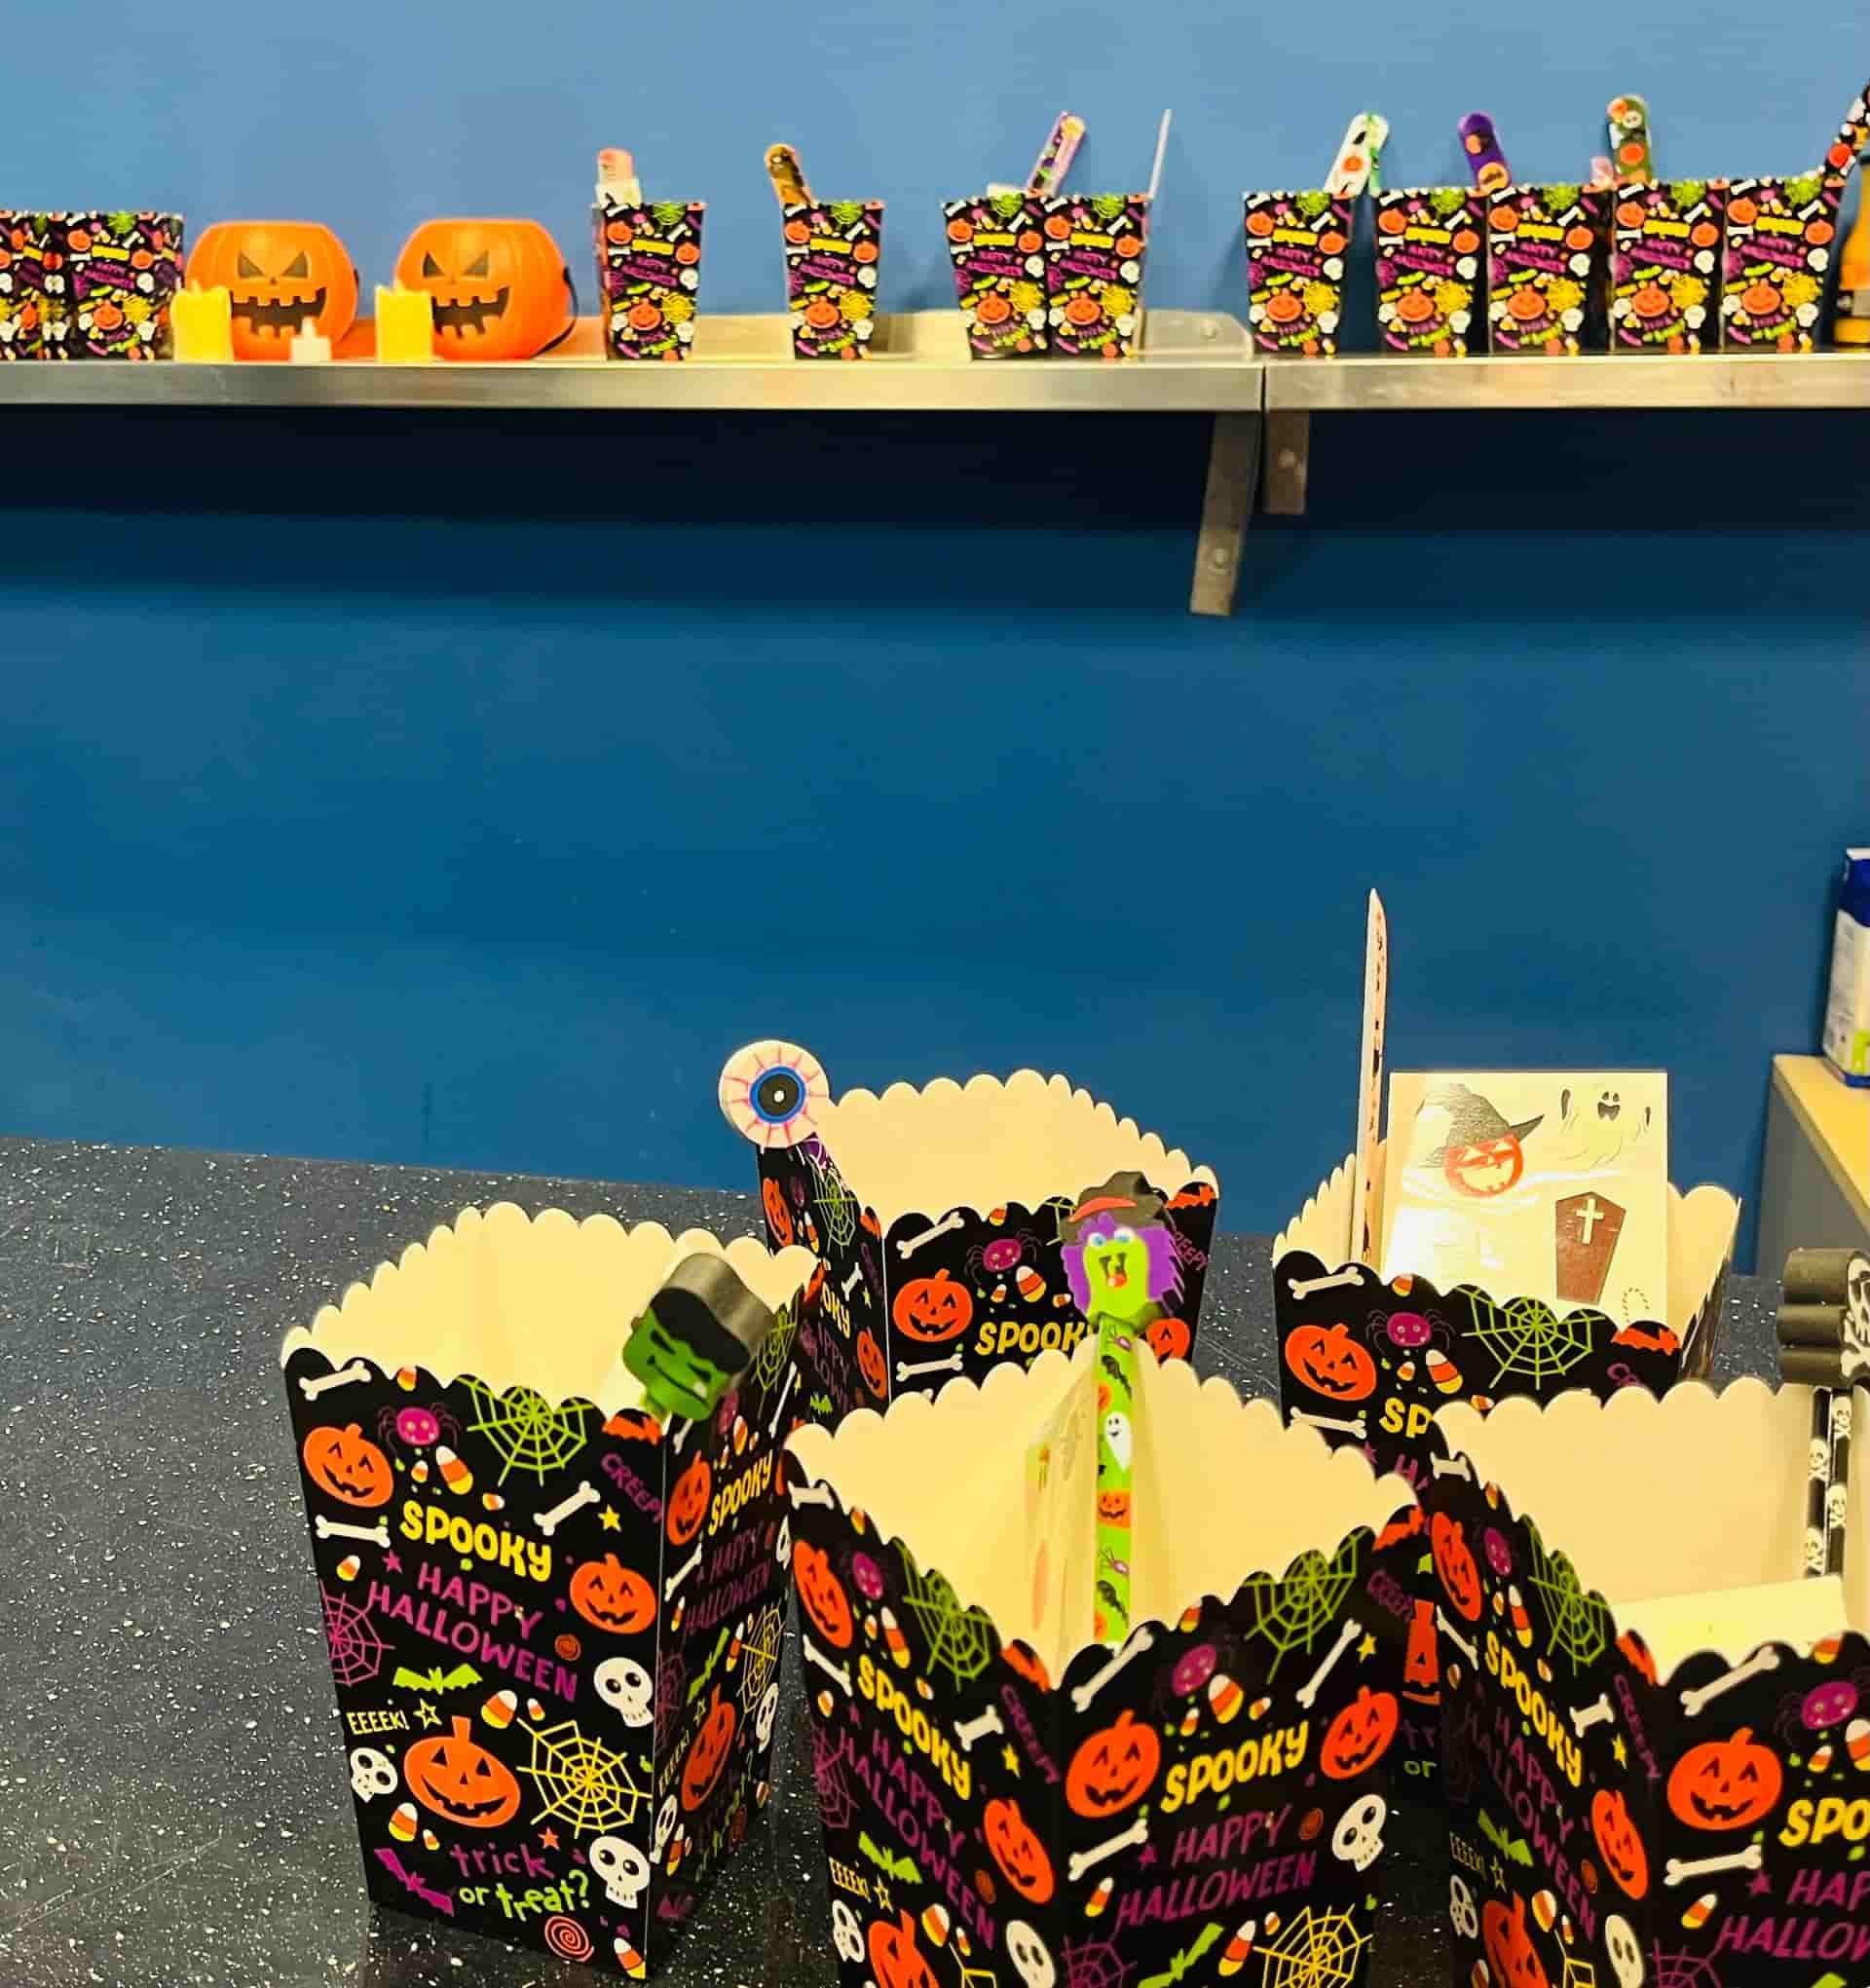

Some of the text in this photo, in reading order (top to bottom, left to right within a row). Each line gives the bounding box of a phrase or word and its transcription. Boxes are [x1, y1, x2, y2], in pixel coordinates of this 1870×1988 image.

[974, 1322, 1090, 1355] SPOOK
[708, 1449, 772, 1535] SPOOKY
[399, 1500, 551, 1582] SPOOKY
[418, 1562, 542, 1639] HAPPY
[367, 1581, 577, 1701] HALLOWEEN
[346, 1711, 409, 1735] EEEEK!
[858, 1654, 970, 1800] SPOOKY
[1484, 1630, 1582, 1787] SPOOKY
[873, 1729, 965, 1857] HAPPY
[1161, 1720, 1308, 1813] SPOOKY
[1403, 1760, 1437, 1778] or
[451, 1842, 554, 1878] trick
[839, 1727, 994, 1949] HALLOWEEN
[1172, 1804, 1292, 1866] HAPPY
[460, 1869, 589, 1922] or treat?
[1118, 1852, 1317, 1926] HALLOWEEN
